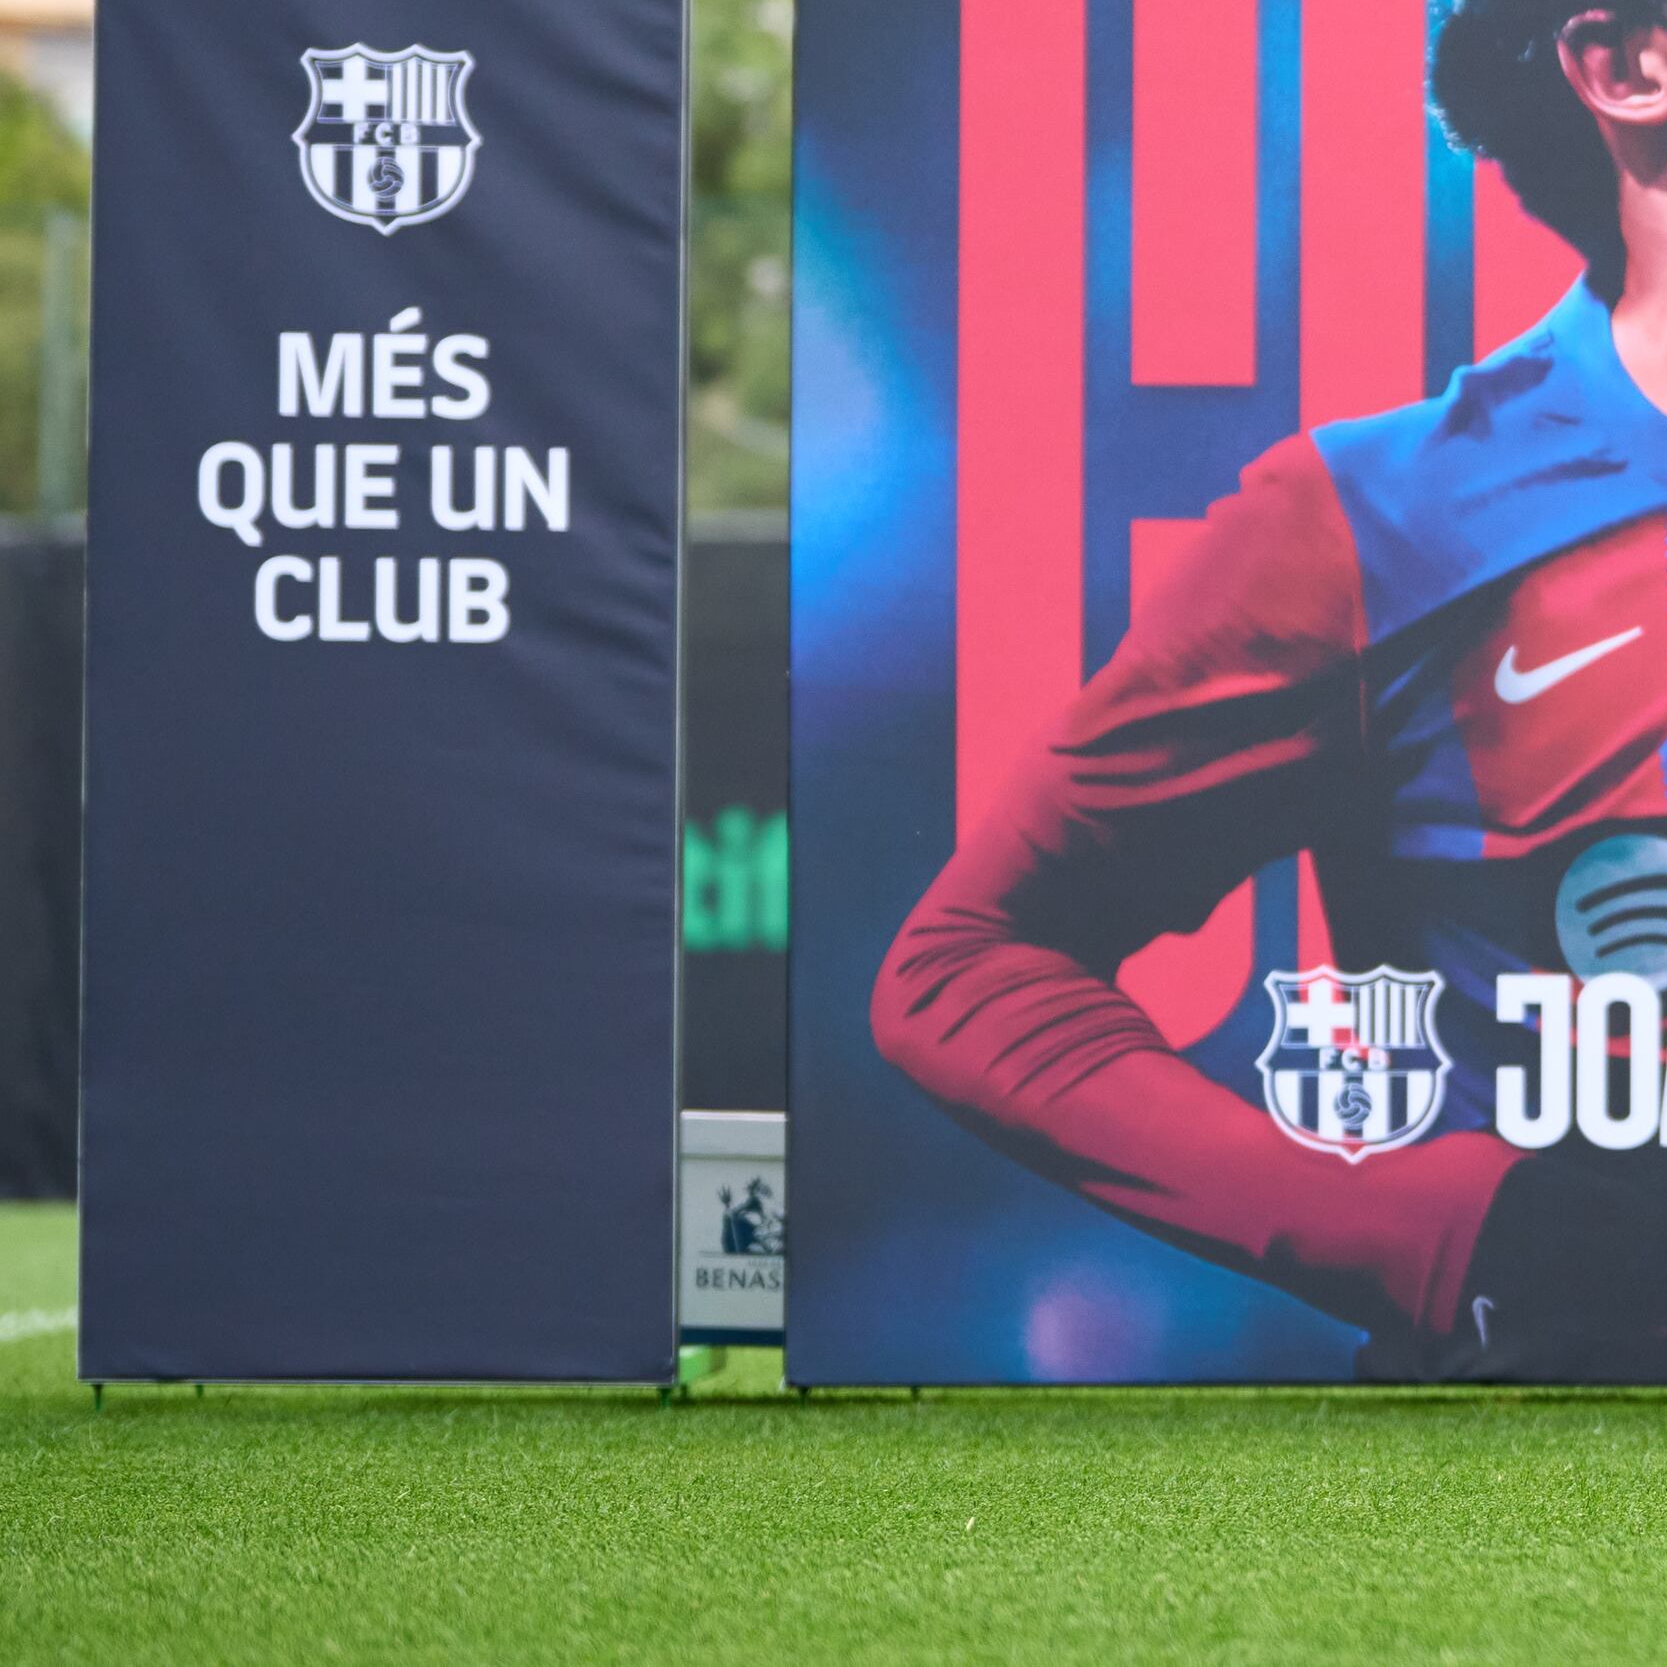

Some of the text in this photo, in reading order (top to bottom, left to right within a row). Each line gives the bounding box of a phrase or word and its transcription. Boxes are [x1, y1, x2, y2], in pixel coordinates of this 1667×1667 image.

[278, 306, 489, 420] MÉS
[198, 441, 569, 547] QUE UN
[254, 555, 511, 643] CLUB
